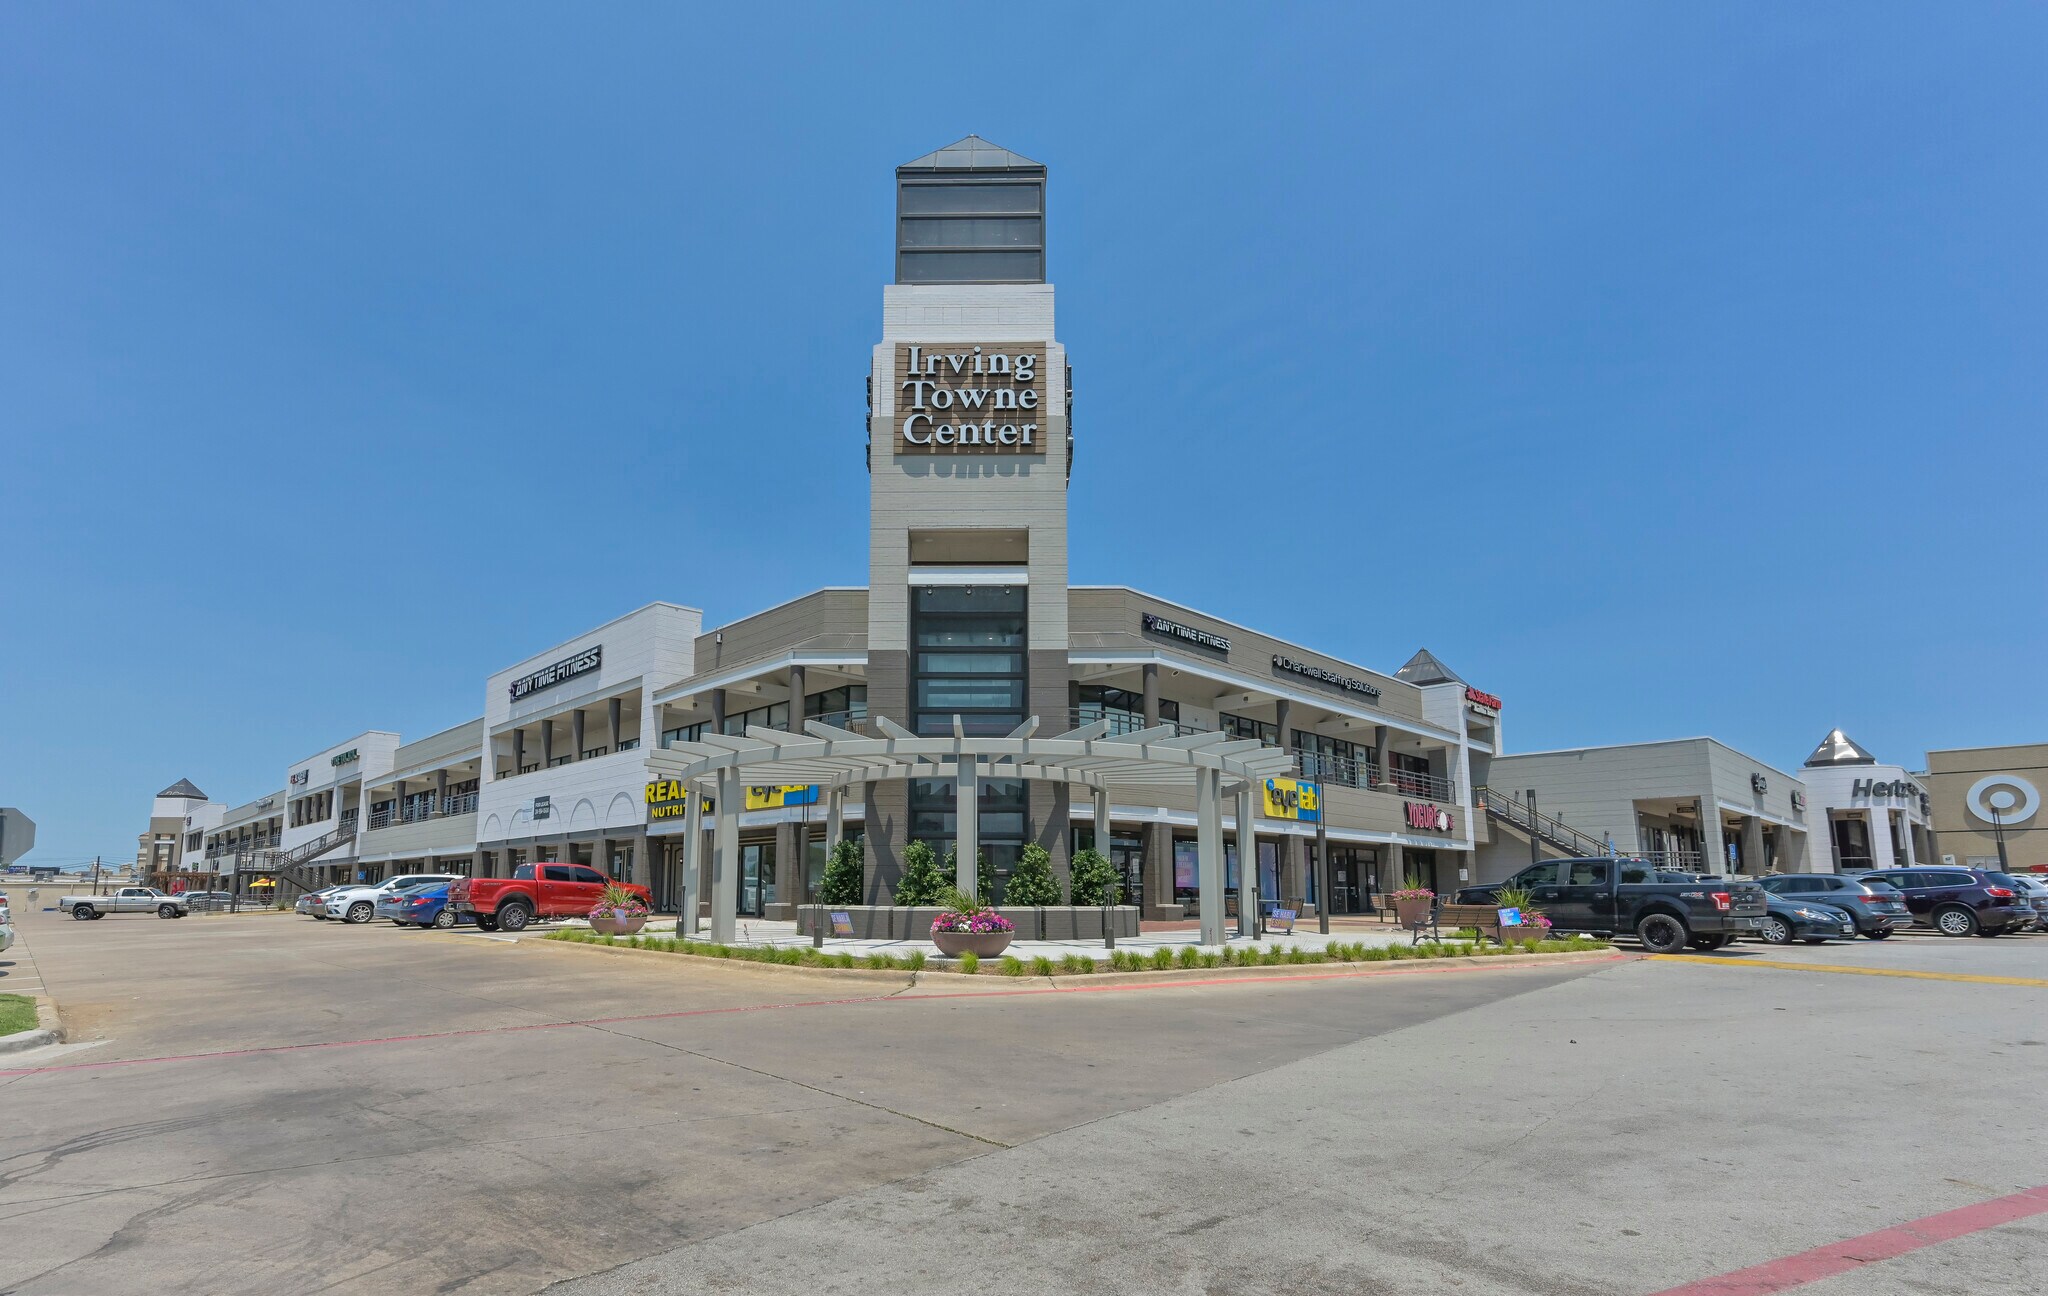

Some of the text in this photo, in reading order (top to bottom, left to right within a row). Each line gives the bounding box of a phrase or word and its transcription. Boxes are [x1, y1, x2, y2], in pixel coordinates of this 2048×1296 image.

[908, 345, 1037, 381] Irving
[902, 380, 1038, 409] Towne
[902, 414, 1038, 445] Center
[1156, 619, 1232, 651] ANYTIME FITNESS
[515, 648, 598, 697] ANYTIME FITNESS
[1283, 656, 1382, 697] Chartwell Staffing Solutions
[651, 801, 710, 818] NUTRIN
[1407, 801, 1437, 830] YOGURT
